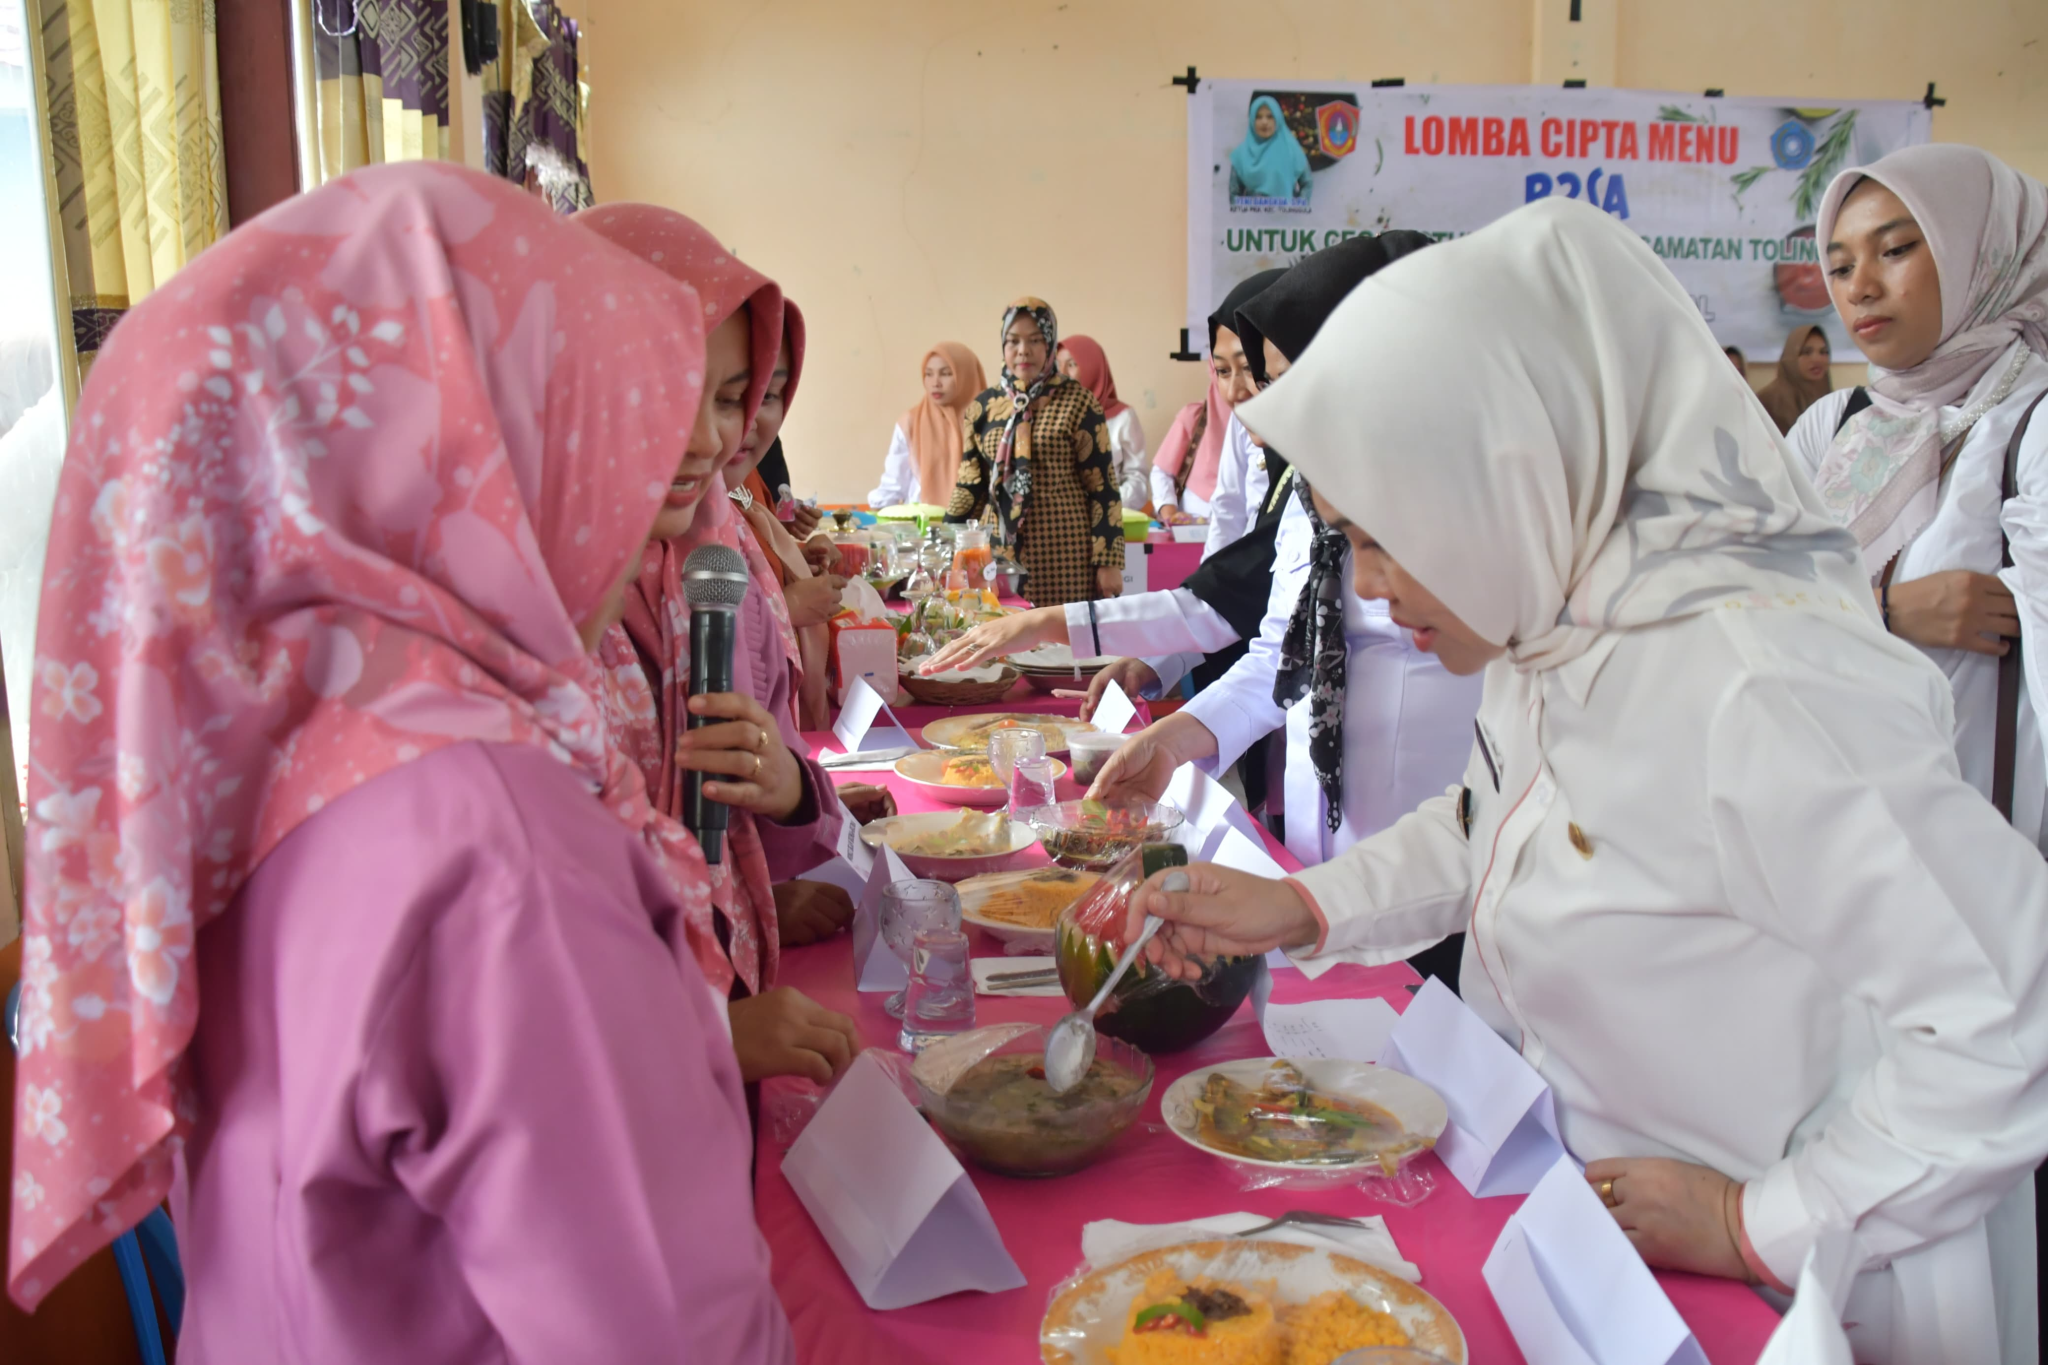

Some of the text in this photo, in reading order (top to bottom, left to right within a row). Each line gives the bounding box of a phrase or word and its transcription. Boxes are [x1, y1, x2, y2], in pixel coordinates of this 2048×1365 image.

[1405, 115, 1740, 165] LOMBA CIPTA MENU
[1227, 228, 1316, 253] UNTUK
[1640, 235, 1742, 261] AMATAN
